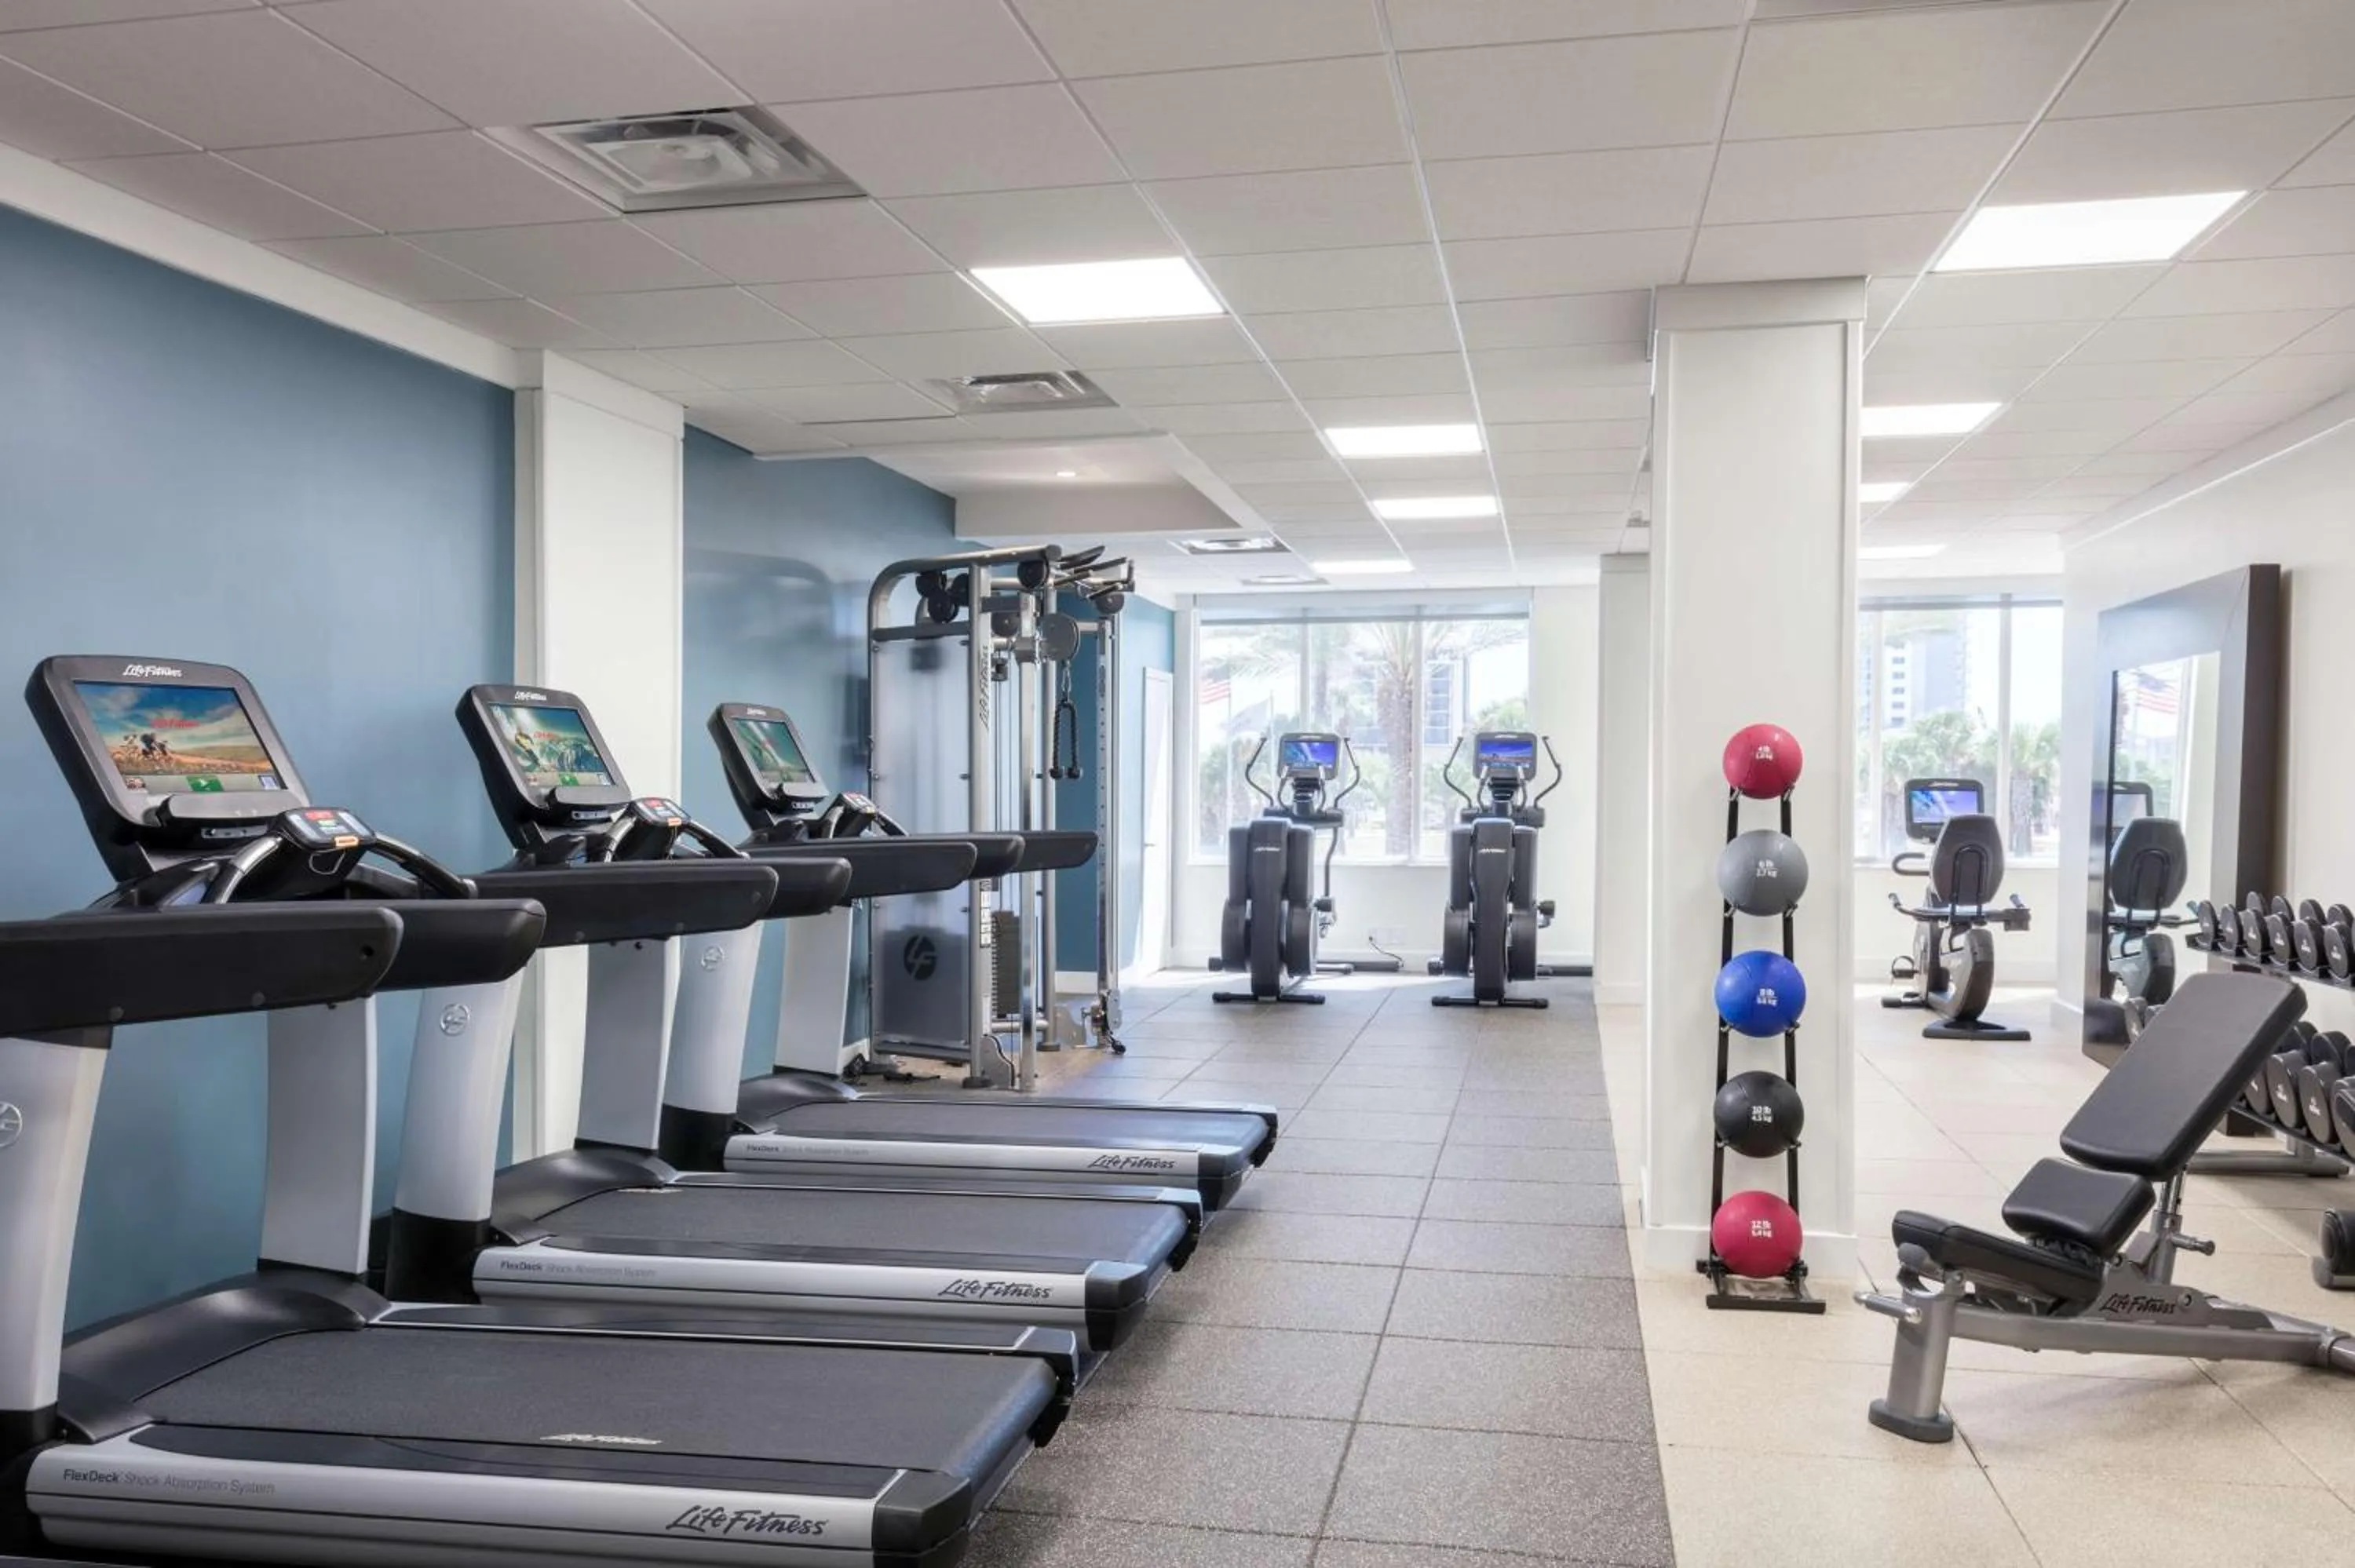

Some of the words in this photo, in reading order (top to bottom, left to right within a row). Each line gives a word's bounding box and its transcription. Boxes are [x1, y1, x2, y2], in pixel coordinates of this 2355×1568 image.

[63, 1468, 119, 1483] FlexDeck
[123, 1471, 159, 1485] Shock
[163, 1474, 228, 1490] Absorption
[230, 1479, 275, 1495] System
